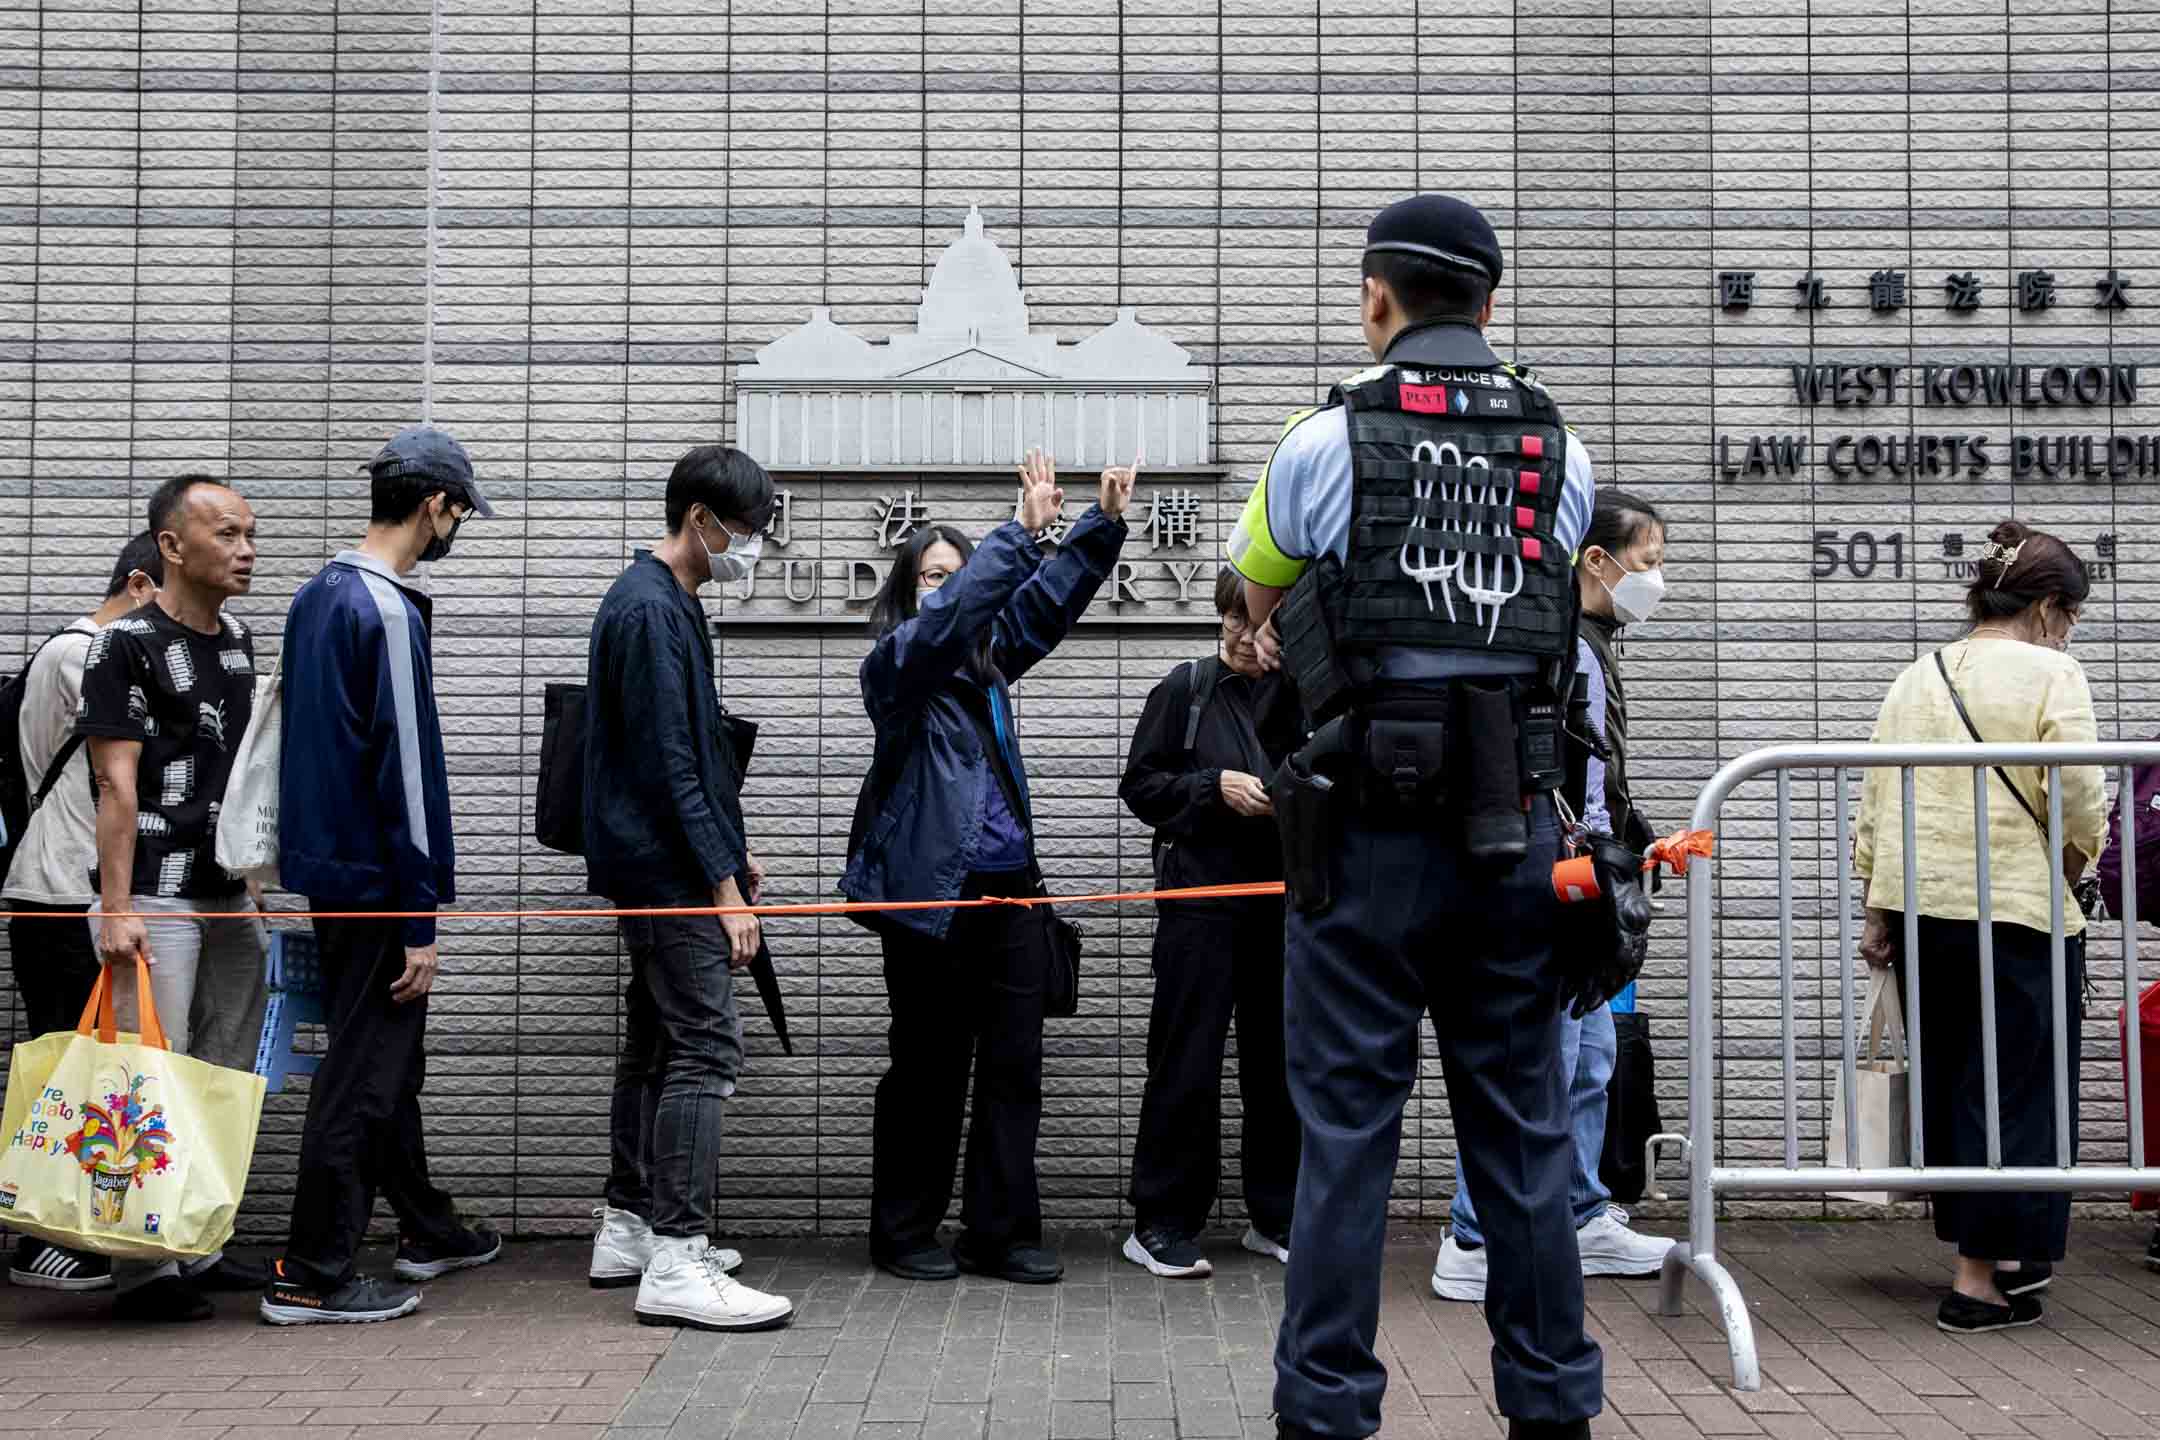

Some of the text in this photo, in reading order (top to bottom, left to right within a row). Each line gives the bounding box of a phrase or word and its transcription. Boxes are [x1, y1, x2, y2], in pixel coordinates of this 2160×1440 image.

[1718, 270, 2131, 311] 西九龍法院大
[1425, 369, 1491, 385] POLICE
[1793, 363, 2138, 405] WEST KOWLOON
[1719, 435, 1806, 479] LAW
[1827, 435, 1992, 478] COURTS
[1811, 531, 1904, 578] 501
[1944, 561, 1984, 578] TUN
[737, 559, 1204, 602] JUDRY
[31, 1101, 73, 1120] otato
[11, 1128, 63, 1157] Happy
